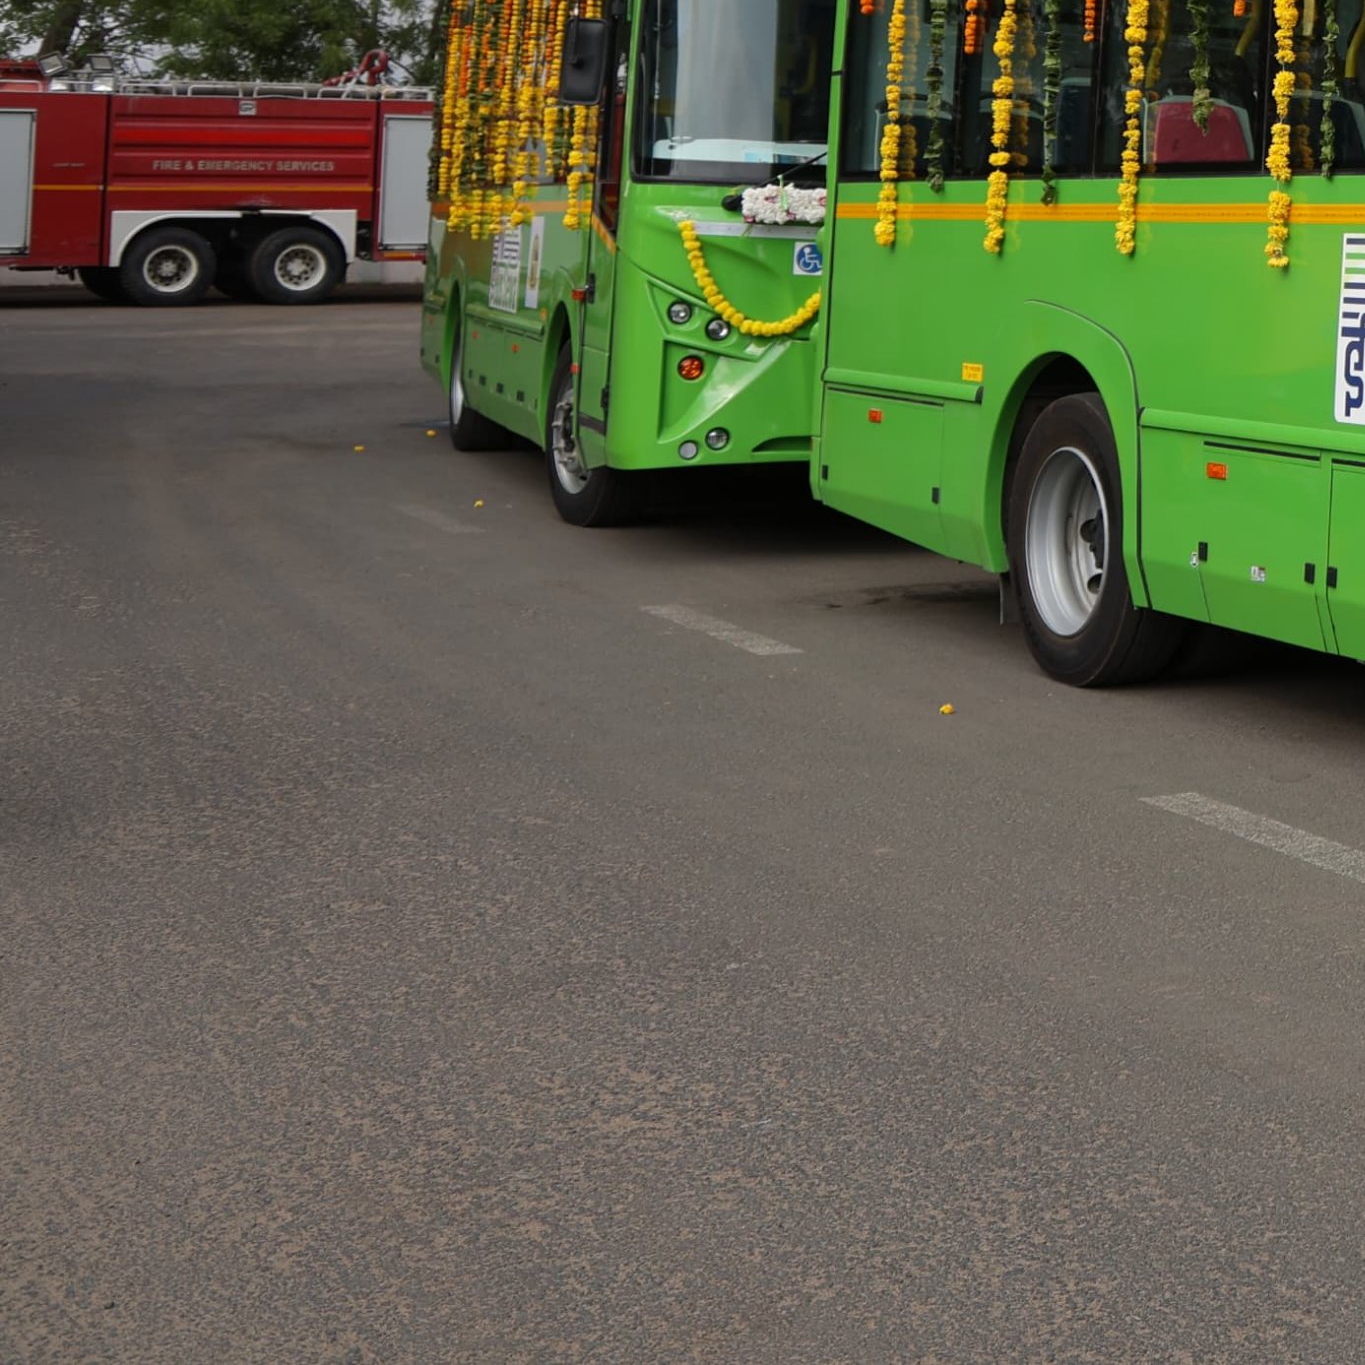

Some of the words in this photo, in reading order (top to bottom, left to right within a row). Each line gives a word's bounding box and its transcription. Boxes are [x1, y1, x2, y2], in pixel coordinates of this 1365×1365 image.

[152, 160, 181, 171] FIRE
[185, 160, 194, 171] &
[197, 160, 272, 171] EMERGENCY
[276, 161, 335, 172] SERVICES
